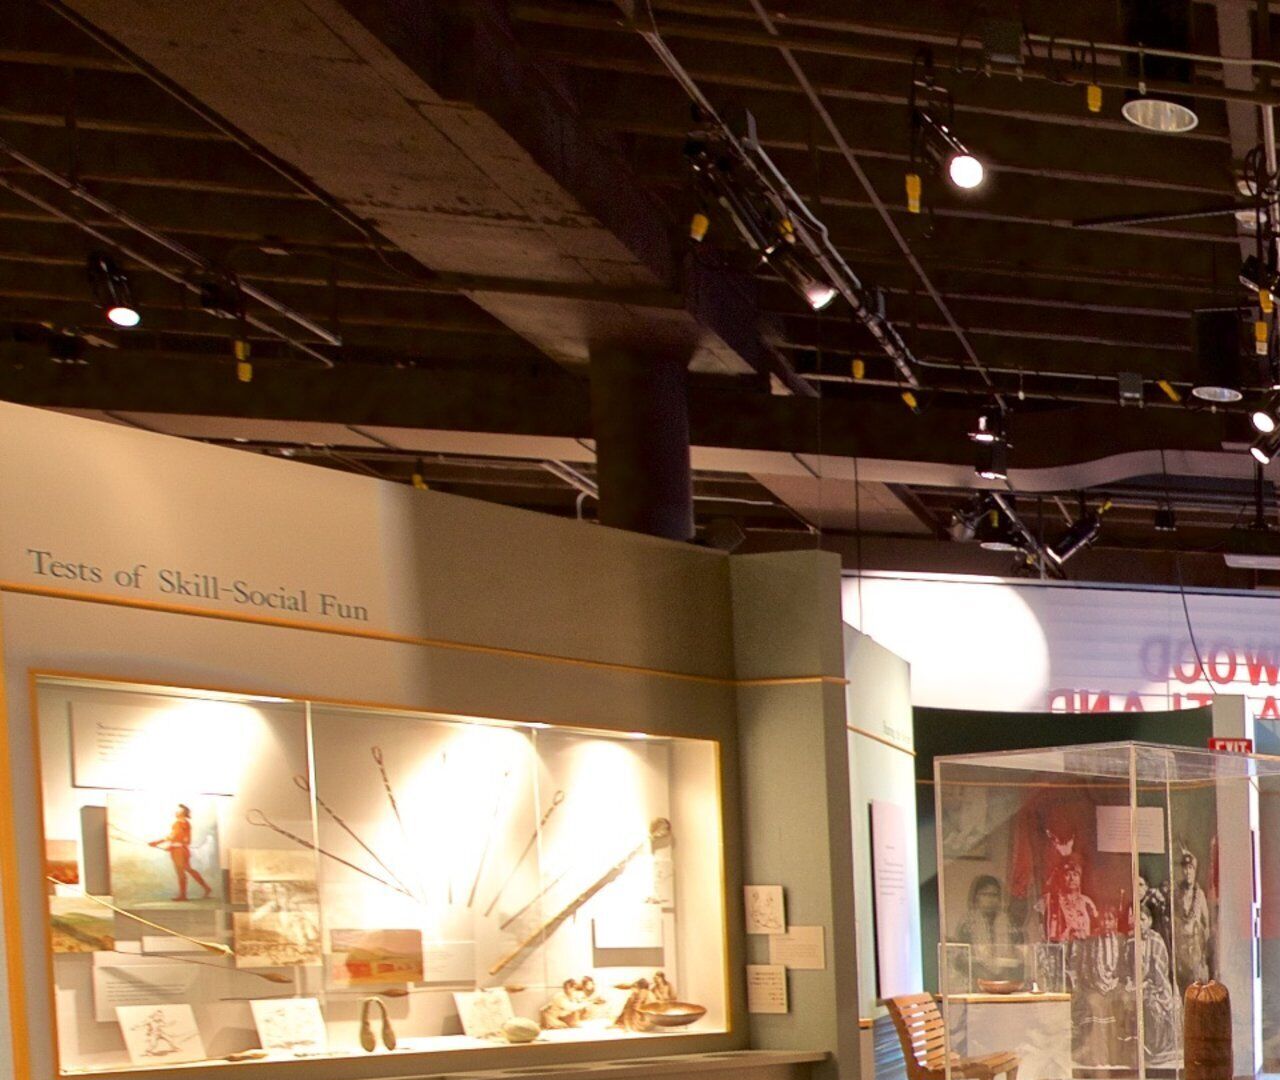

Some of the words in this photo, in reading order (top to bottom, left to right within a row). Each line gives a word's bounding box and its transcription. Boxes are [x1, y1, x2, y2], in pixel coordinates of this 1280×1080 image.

[27, 548, 103, 584] Tests
[114, 564, 147, 588] of
[158, 568, 308, 613] Skill-Social
[318, 592, 369, 621] Fun
